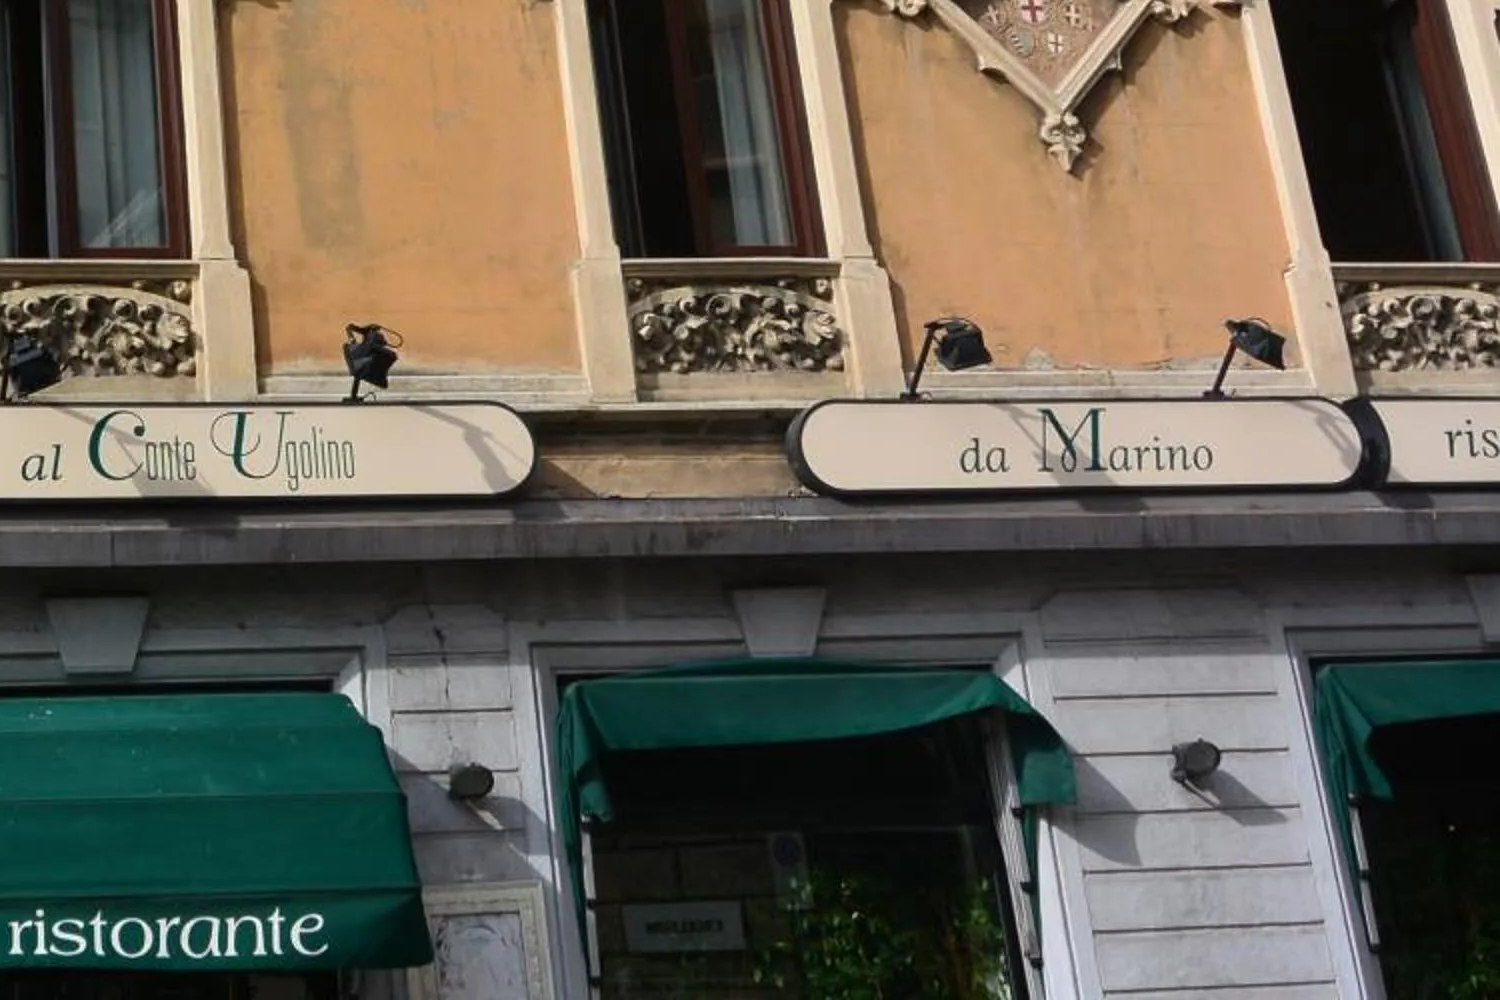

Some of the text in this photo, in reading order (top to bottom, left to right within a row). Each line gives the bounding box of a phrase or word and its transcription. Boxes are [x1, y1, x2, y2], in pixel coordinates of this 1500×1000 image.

[20, 409, 356, 492] al Conte Ugolino
[959, 407, 1214, 473] da Marino
[1443, 418, 1500, 459] ris
[8, 905, 329, 960] ristorante
